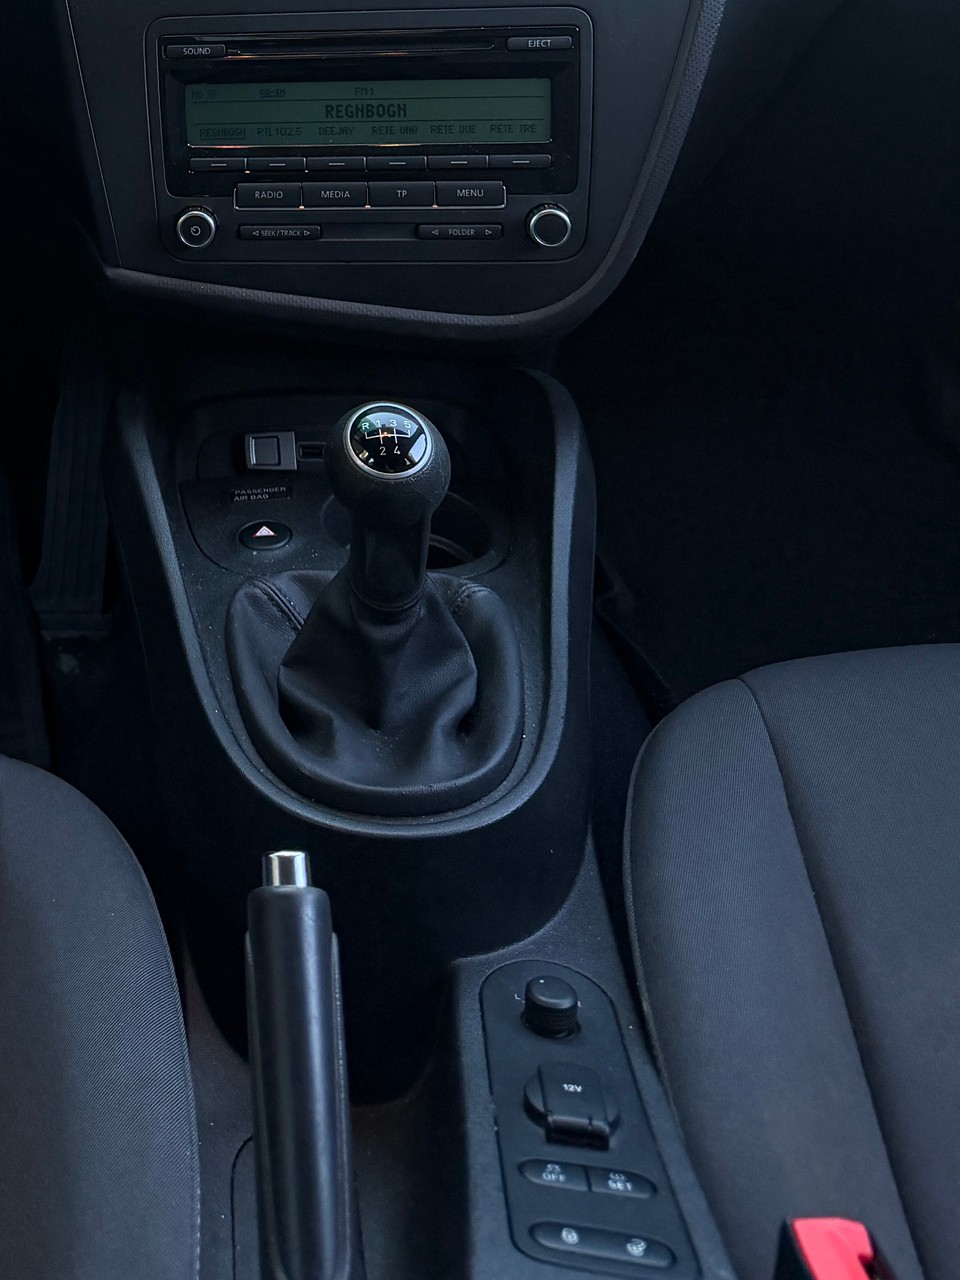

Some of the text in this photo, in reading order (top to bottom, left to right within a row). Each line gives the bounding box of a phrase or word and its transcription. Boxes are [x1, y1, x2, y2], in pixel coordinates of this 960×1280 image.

[528, 39, 552, 48] EJECT
[183, 47, 211, 55] SOUND
[319, 126, 354, 135] DEEJAY
[254, 191, 283, 199] RADIO
[321, 190, 351, 198] MEDIA
[397, 190, 407, 198] TP
[457, 189, 484, 197] MENU
[448, 228, 475, 236] FOLDER
[362, 422, 370, 430] R
[380, 446, 400, 455] 2 4
[234, 486, 286, 495] PASSENGER
[562, 1083, 582, 1093] 12V
[542, 1172, 566, 1182] OFF
